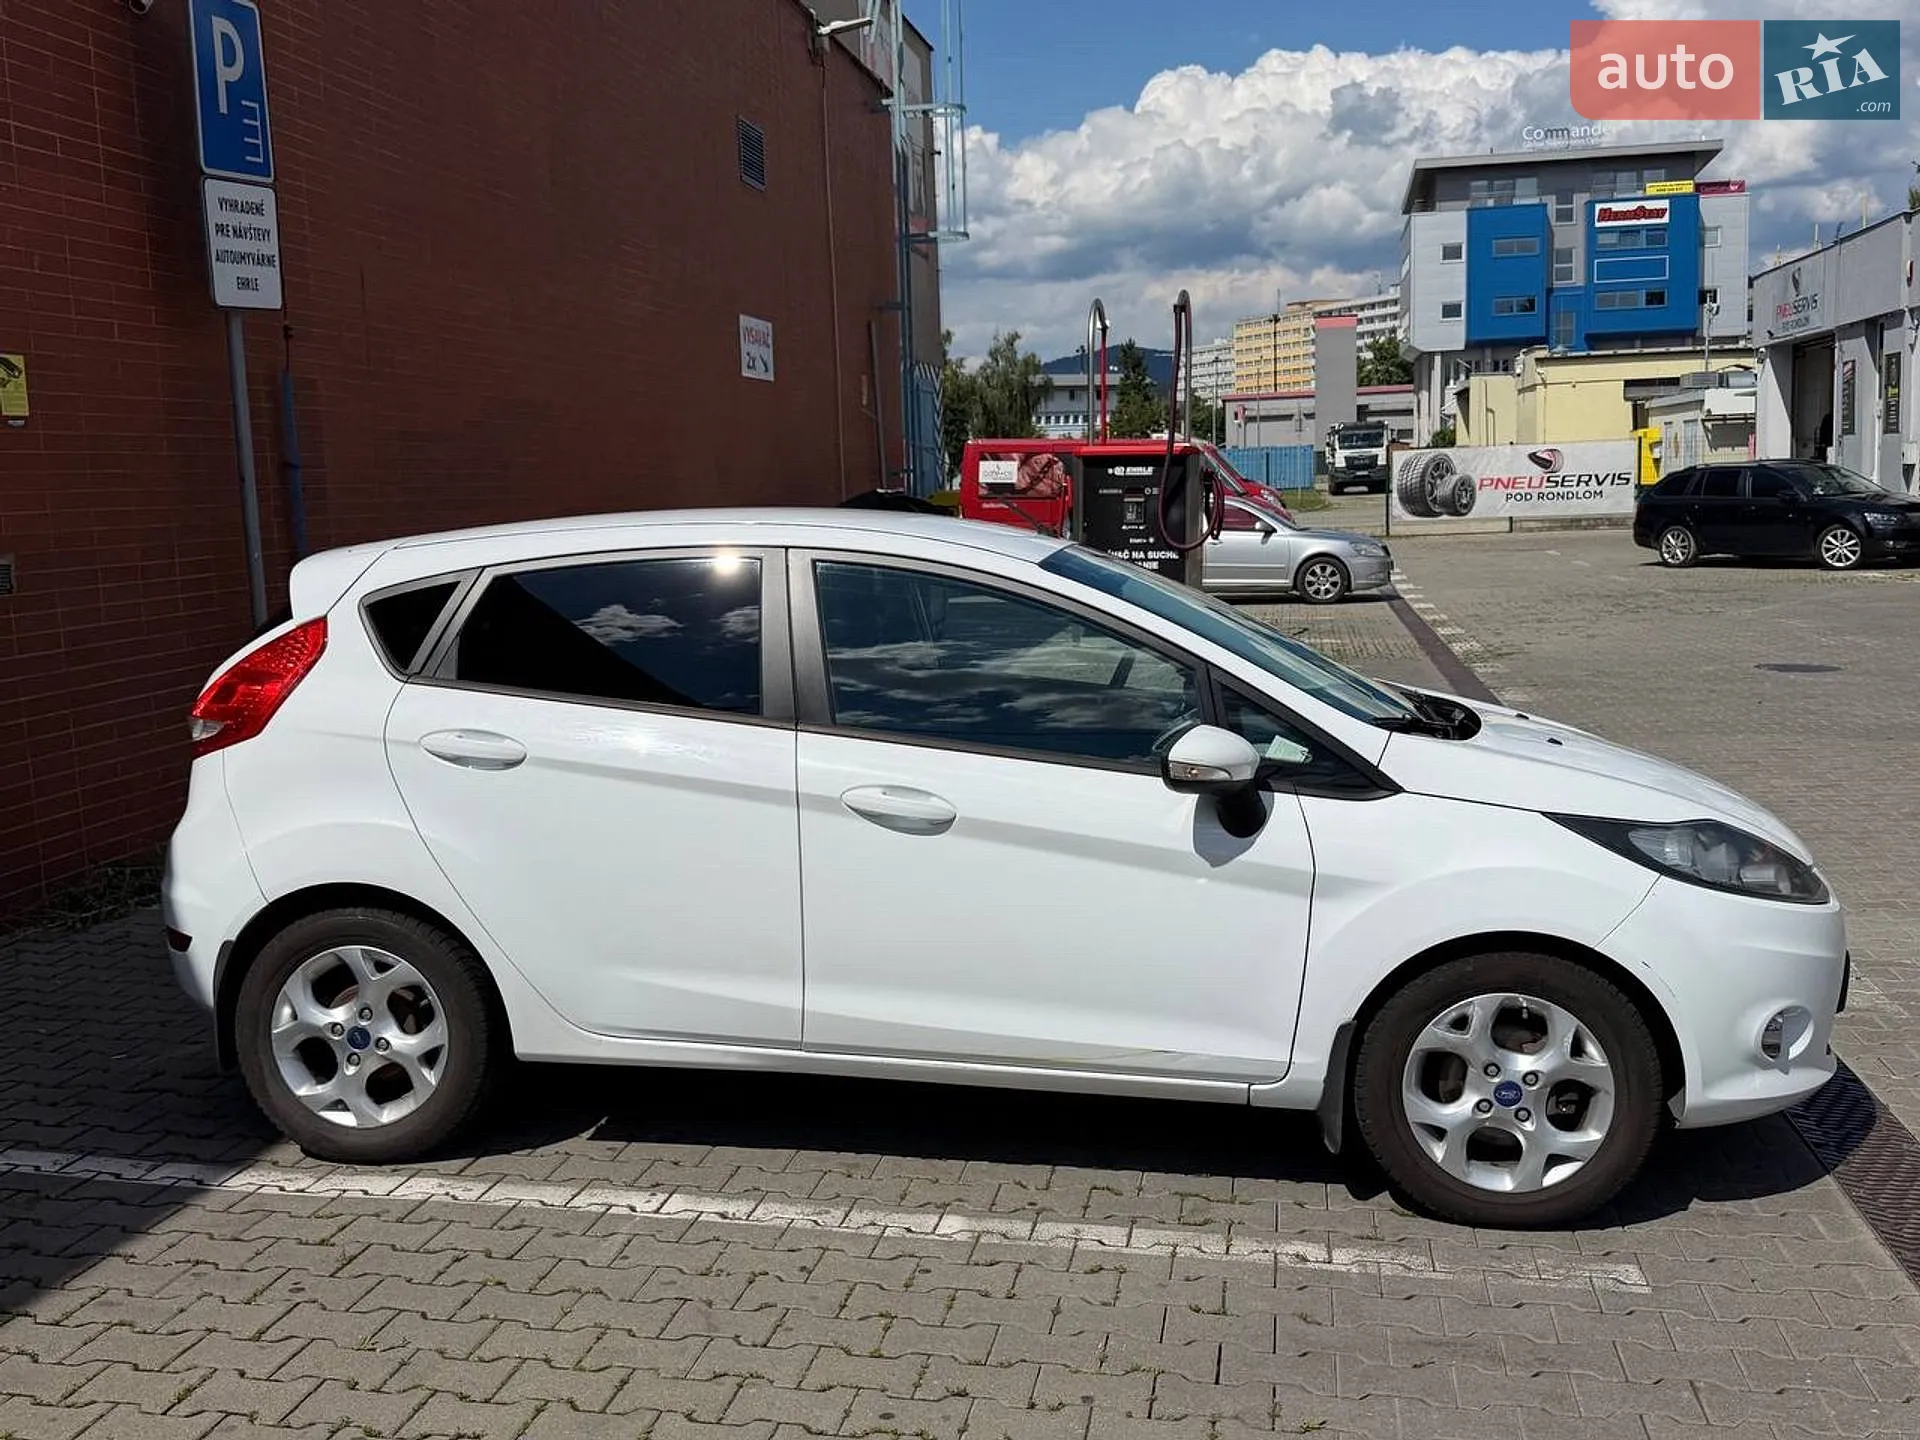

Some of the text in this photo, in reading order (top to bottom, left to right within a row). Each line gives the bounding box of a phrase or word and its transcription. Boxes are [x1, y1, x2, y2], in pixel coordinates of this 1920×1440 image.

[211, 15, 244, 114] P
[1522, 124, 1608, 140] Command
[215, 223, 231, 238] PRE
[1478, 472, 1631, 491] PNEUSERVIS
[1506, 490, 1603, 503] POD RONDLOM
[1132, 551, 1146, 560] NA
